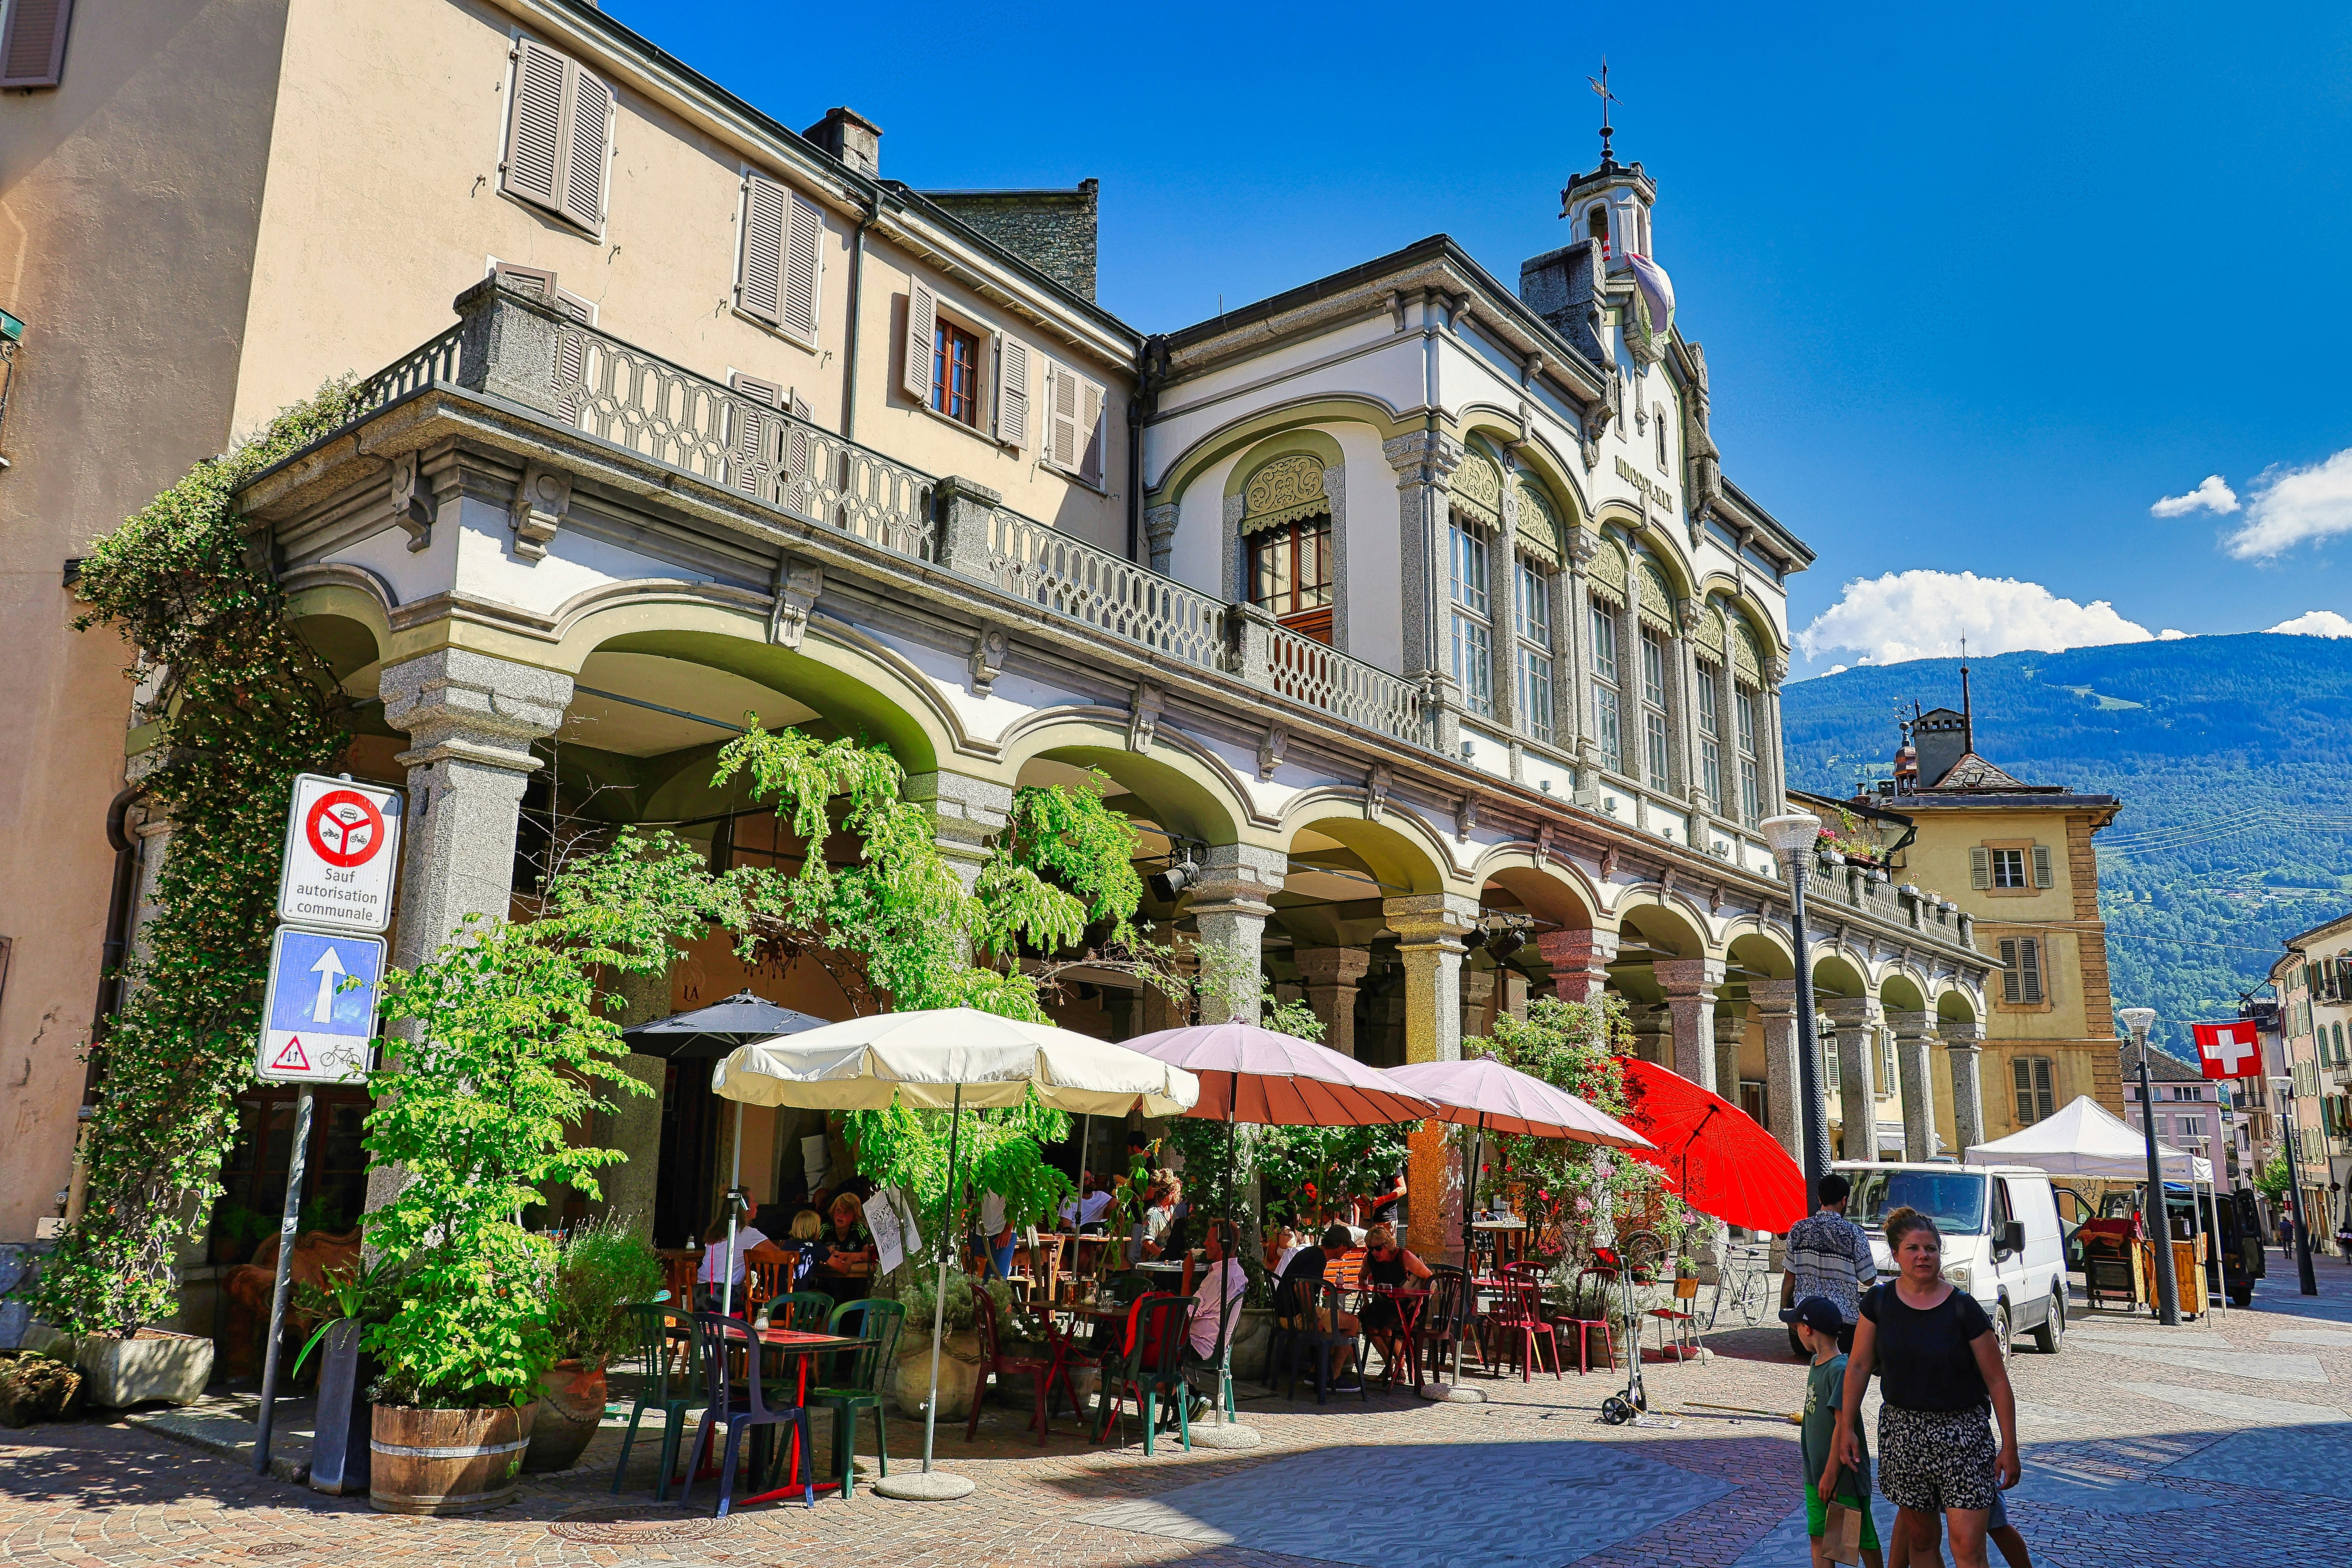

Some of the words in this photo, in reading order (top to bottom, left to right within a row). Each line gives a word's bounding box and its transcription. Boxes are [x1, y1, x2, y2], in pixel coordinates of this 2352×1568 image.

[325, 868, 356, 883] Sauf
[297, 885, 377, 904] autorisation
[297, 903, 372, 920] communale
[2293, 1130, 2302, 1161] OPTICIEN
